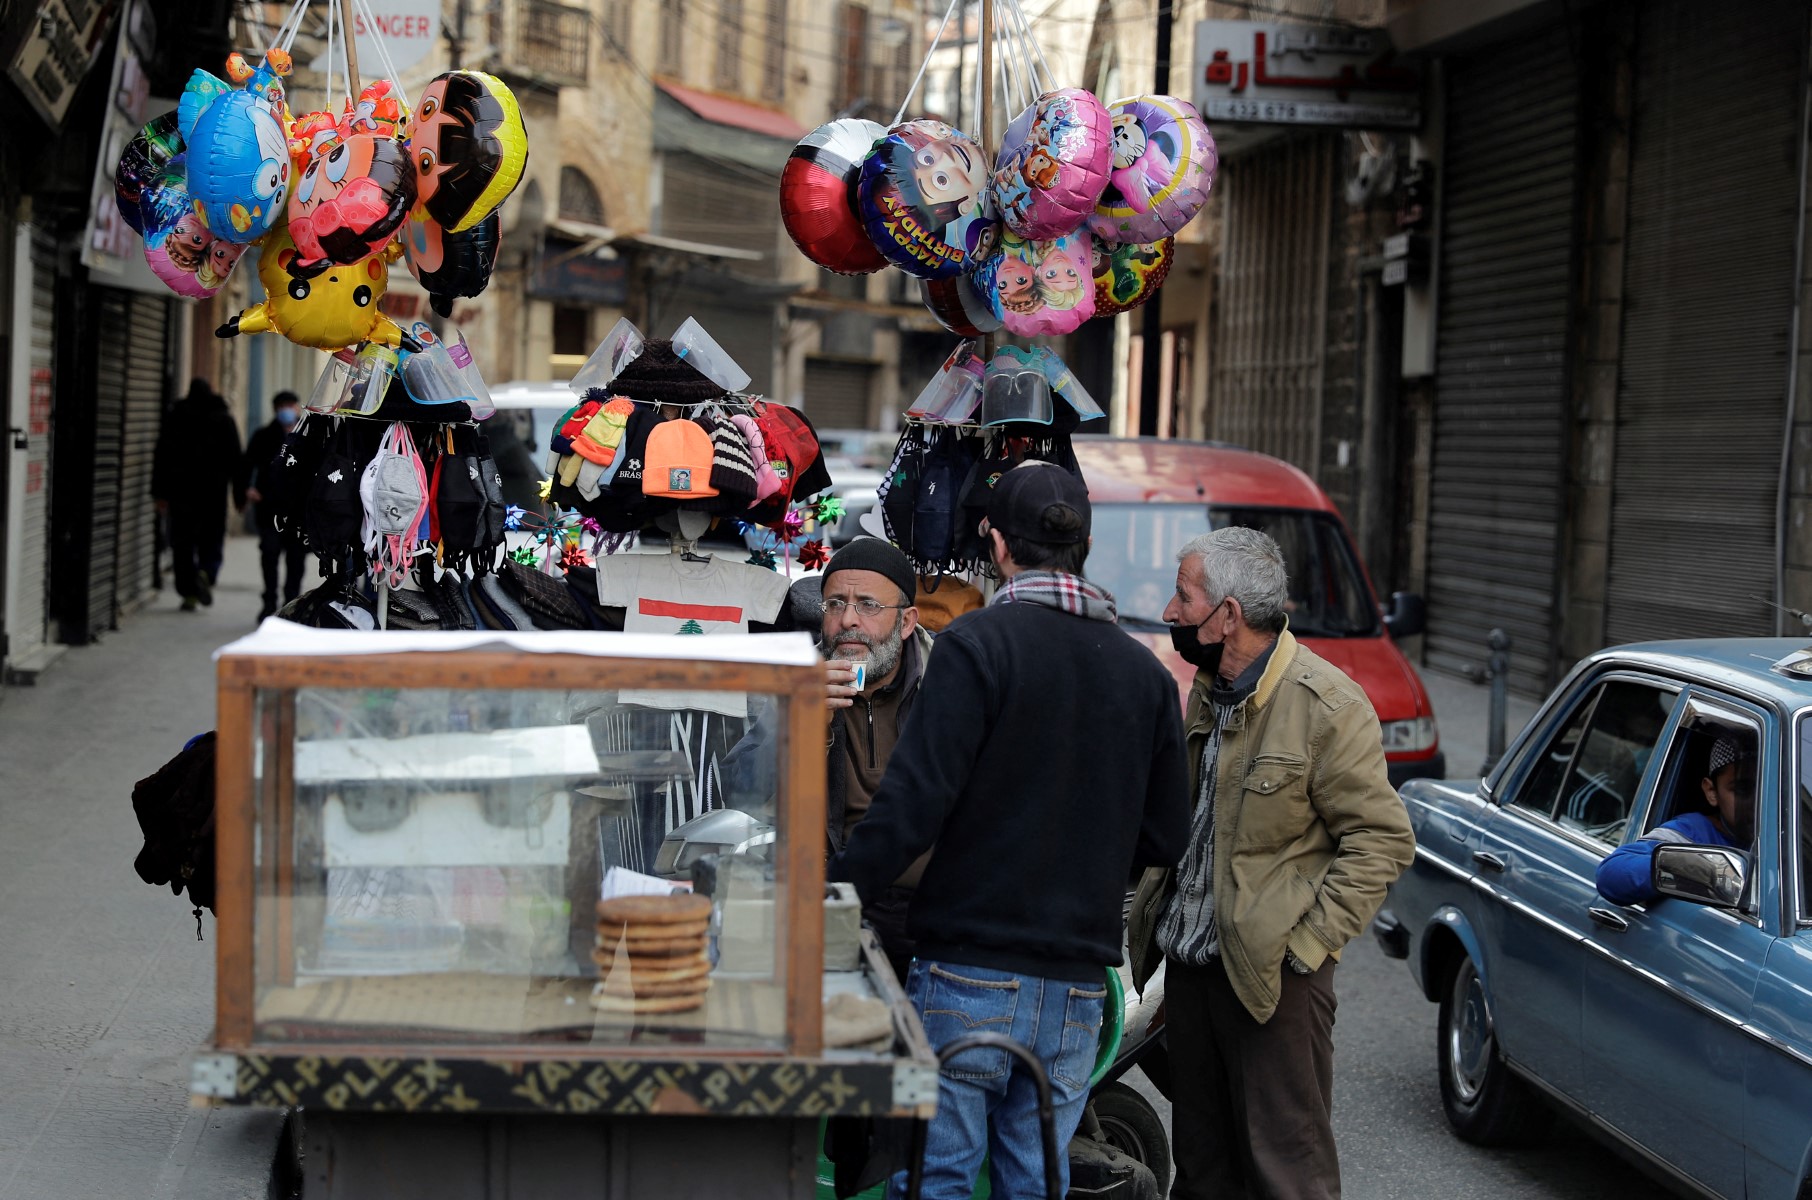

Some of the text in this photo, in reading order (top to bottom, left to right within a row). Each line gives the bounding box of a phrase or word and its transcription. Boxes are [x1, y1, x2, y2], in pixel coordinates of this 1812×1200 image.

[883, 196, 966, 263] BIRTHDAY
[883, 221, 945, 269] HAPPY
[618, 470, 643, 480] BRAS
